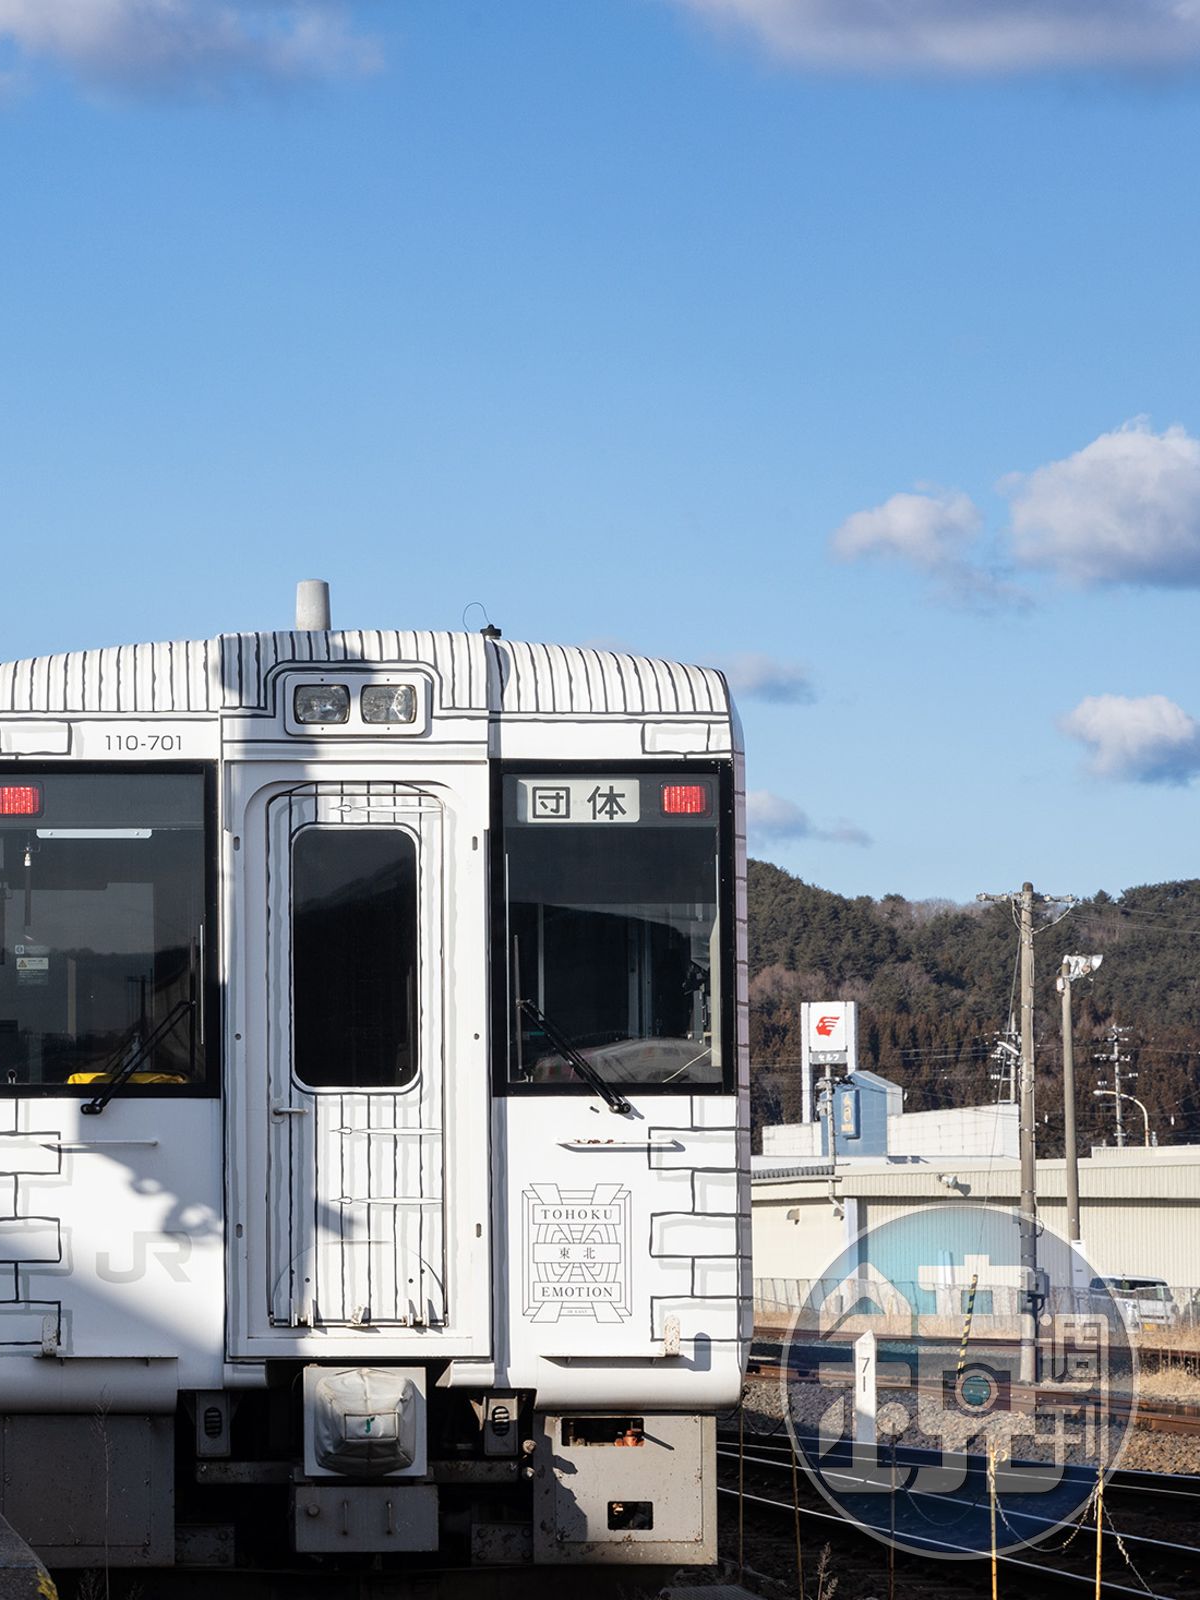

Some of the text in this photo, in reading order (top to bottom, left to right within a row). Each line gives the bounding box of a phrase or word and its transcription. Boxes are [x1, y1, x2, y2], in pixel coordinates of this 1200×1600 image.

[105, 735, 182, 751] 110-701
[532, 785, 627, 820] 団体
[540, 1209, 613, 1220] TOHOKU
[95, 1231, 193, 1285] JR
[559, 1247, 596, 1260] 東北
[541, 1286, 613, 1298] EMOTION
